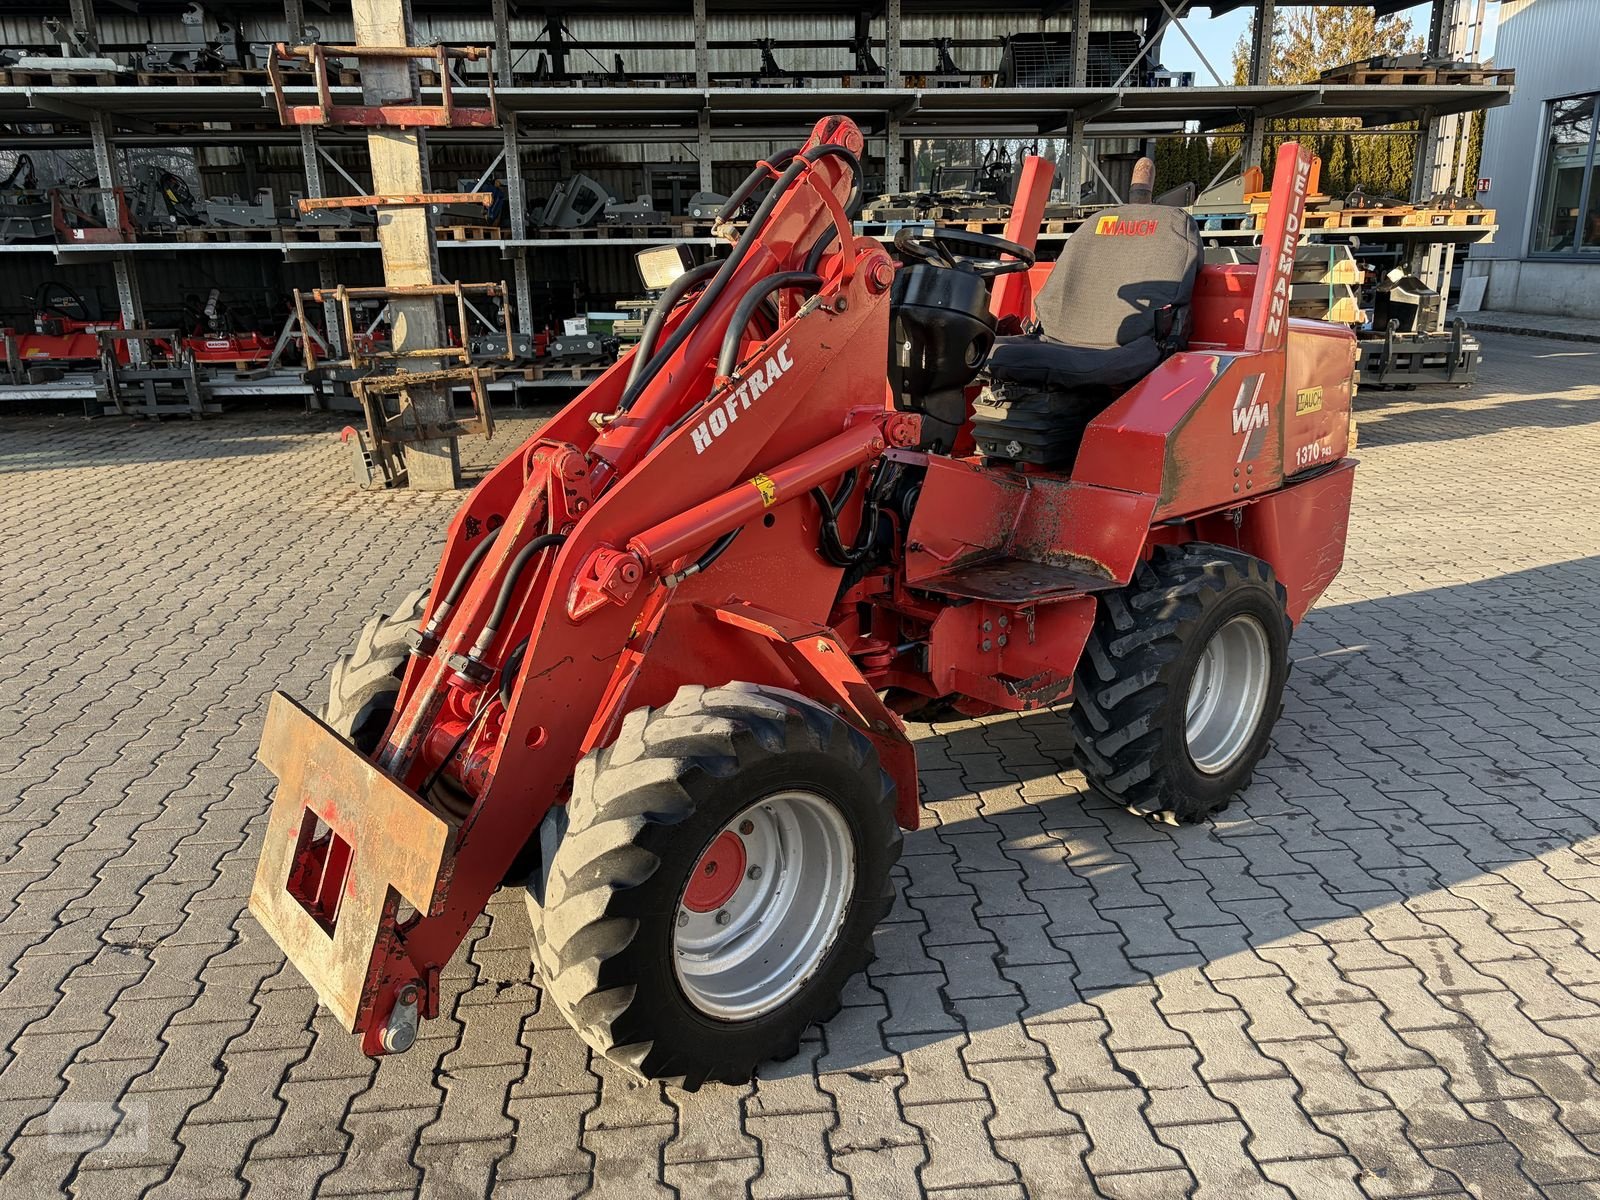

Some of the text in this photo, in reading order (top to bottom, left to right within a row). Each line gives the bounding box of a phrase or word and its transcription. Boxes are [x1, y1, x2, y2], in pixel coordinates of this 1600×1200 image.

[1101, 220, 1158, 236] MAUCH
[1267, 157, 1311, 337] WEIDEMANN
[690, 343, 794, 455] HOFTRAC
[1296, 391, 1322, 413] MAUCH
[1232, 402, 1269, 434] WM
[1296, 443, 1320, 465] 1370
